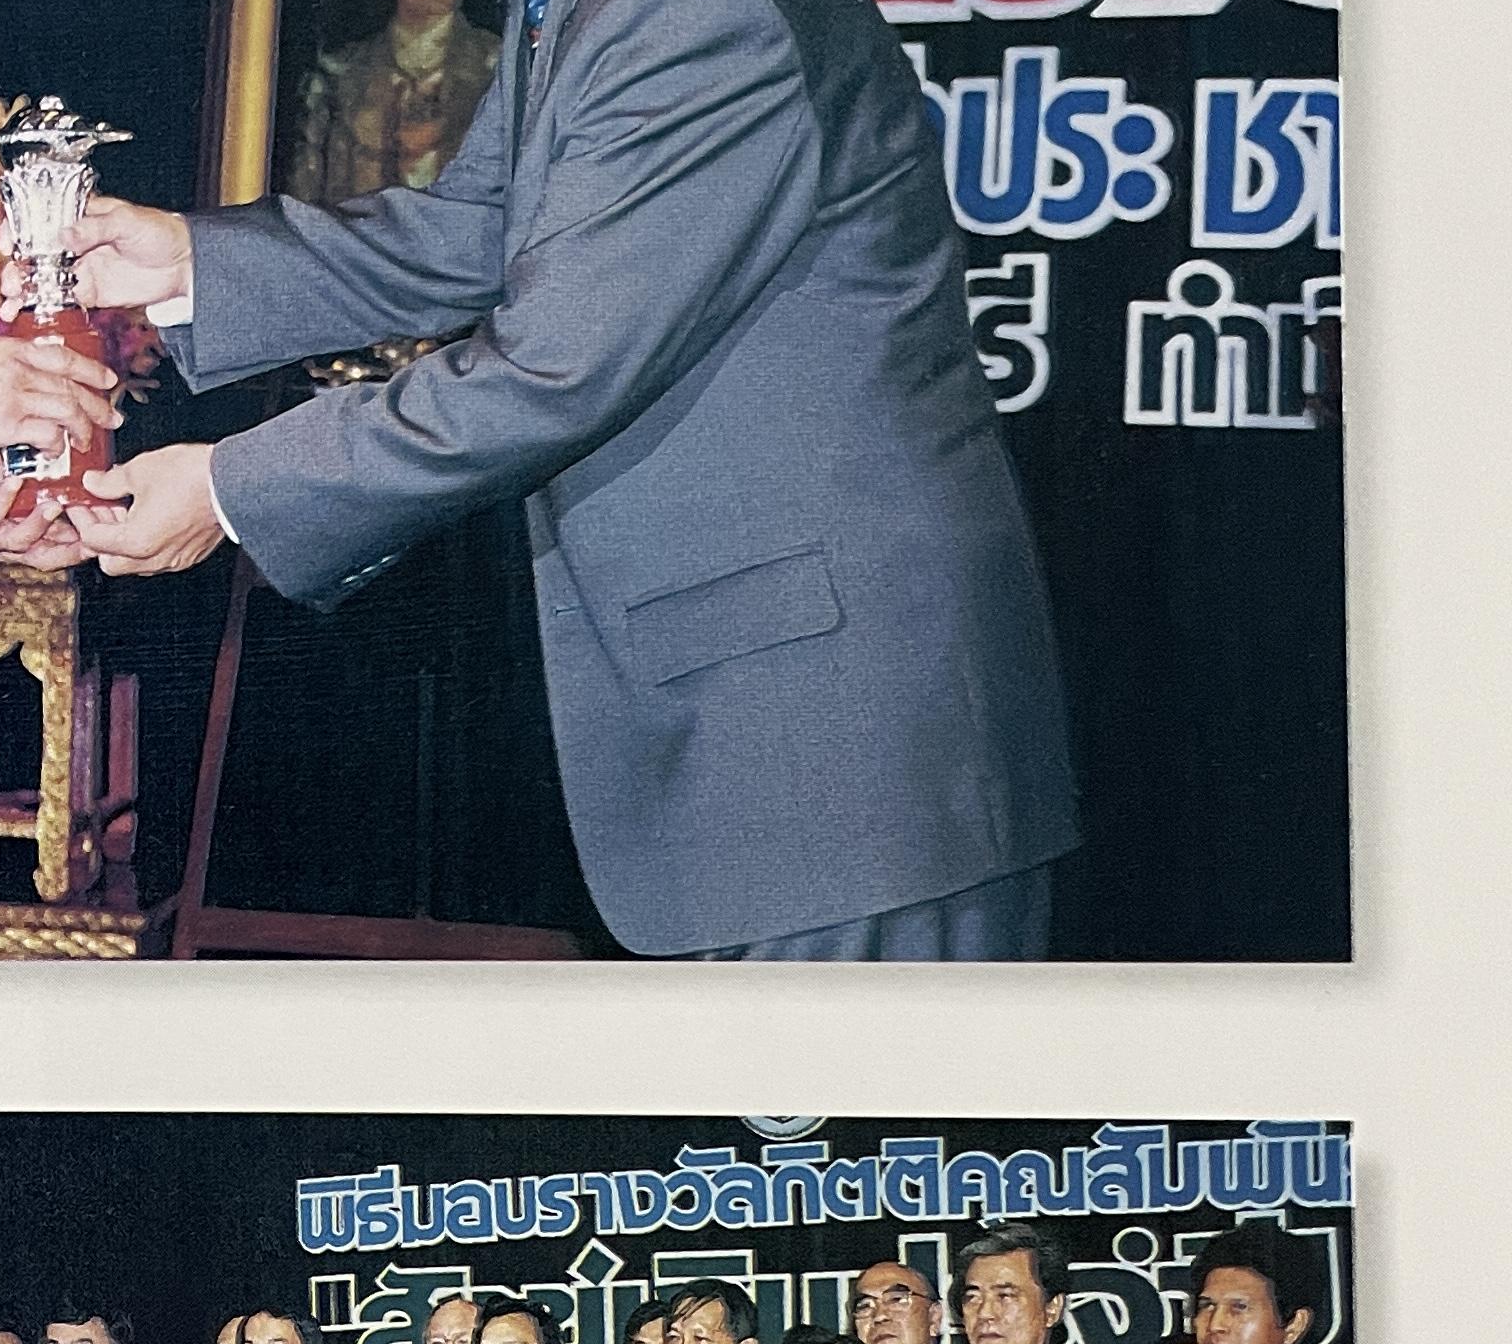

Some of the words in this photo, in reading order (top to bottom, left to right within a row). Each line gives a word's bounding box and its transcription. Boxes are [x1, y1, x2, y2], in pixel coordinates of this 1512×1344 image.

[296, 1119, 1354, 1254] พิธีมอบรางวัลกิตติคณสัมพัน
